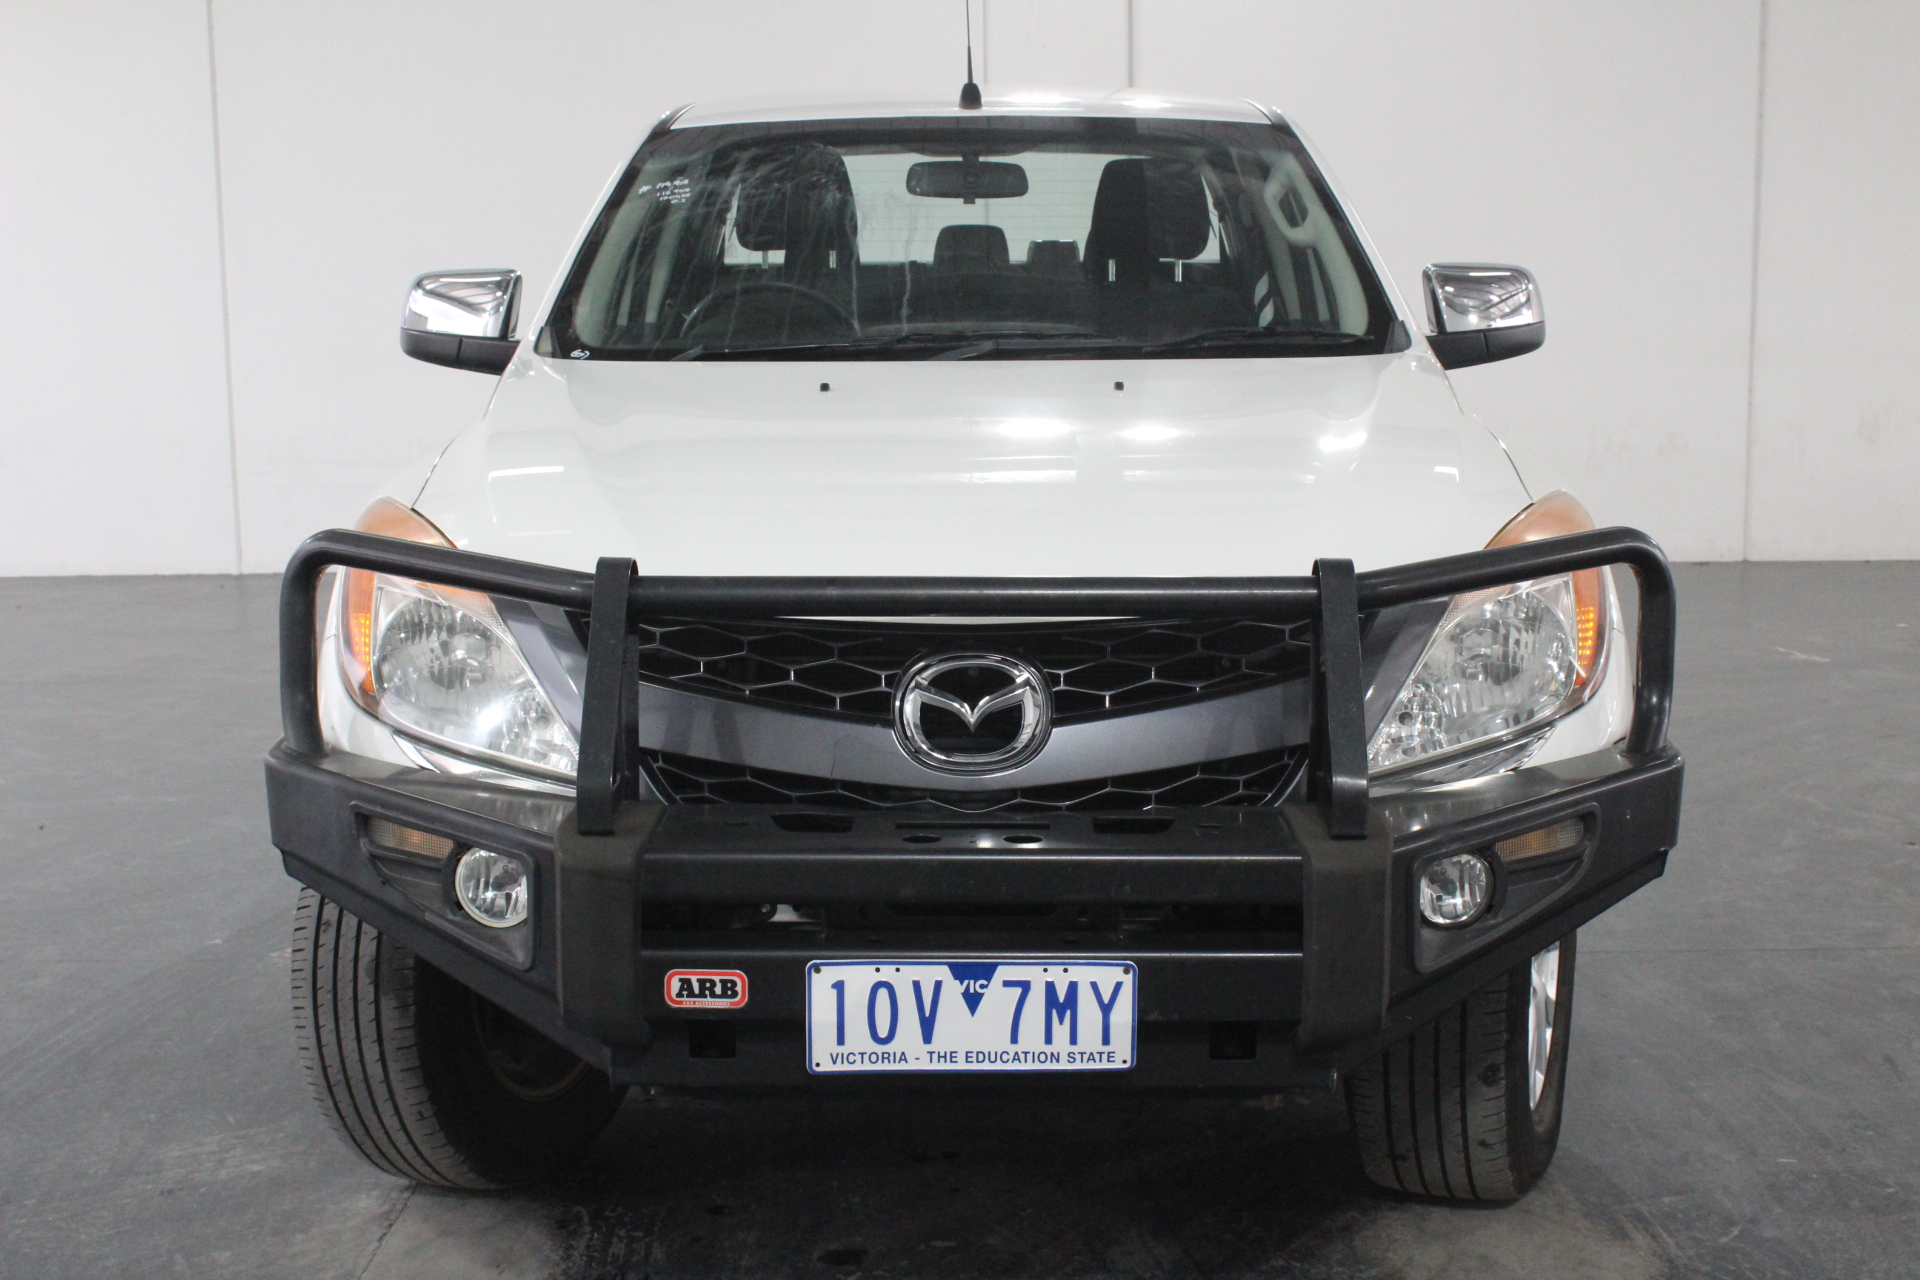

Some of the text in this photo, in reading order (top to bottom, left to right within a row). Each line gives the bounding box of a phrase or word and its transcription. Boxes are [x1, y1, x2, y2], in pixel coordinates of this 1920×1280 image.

[675, 978, 739, 999] ARB
[956, 979, 989, 994] VIC
[1002, 979, 1125, 1046] 7MY
[829, 1051, 909, 1065] VICTORIA
[926, 1050, 959, 1064] THE
[964, 1050, 1061, 1064] EDUCATION
[1066, 1050, 1117, 1064] STATE
